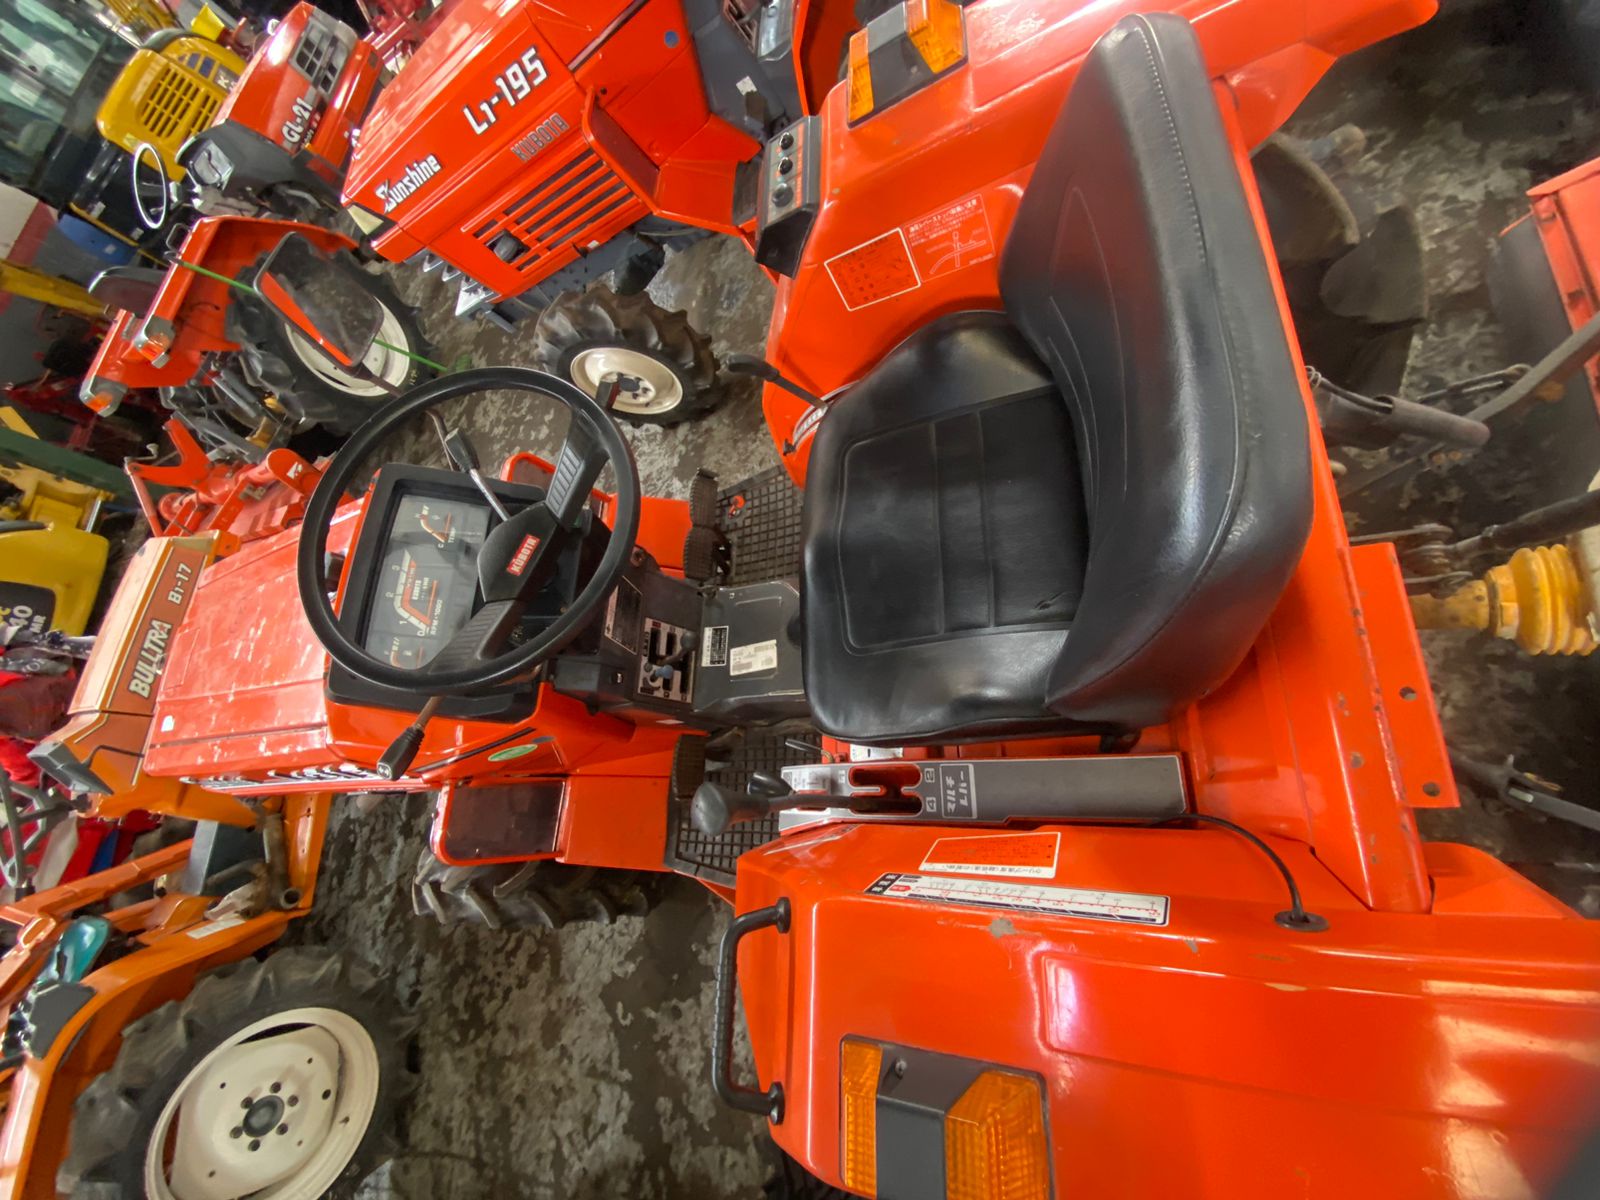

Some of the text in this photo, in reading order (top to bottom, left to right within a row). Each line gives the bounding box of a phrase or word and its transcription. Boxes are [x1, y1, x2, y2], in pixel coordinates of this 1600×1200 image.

[464, 46, 548, 135] L1-195
[511, 112, 569, 163] KUBOTA
[375, 153, 442, 213] Sunshine
[511, 537, 537, 573] KUBOTA
[168, 563, 192, 605] B1-17
[29, 614, 47, 634] MR
[129, 619, 173, 698] BULLTRA
[926, 769, 933, 781] 2
[945, 776, 957, 813] マルチ
[926, 798, 935, 811] 4
